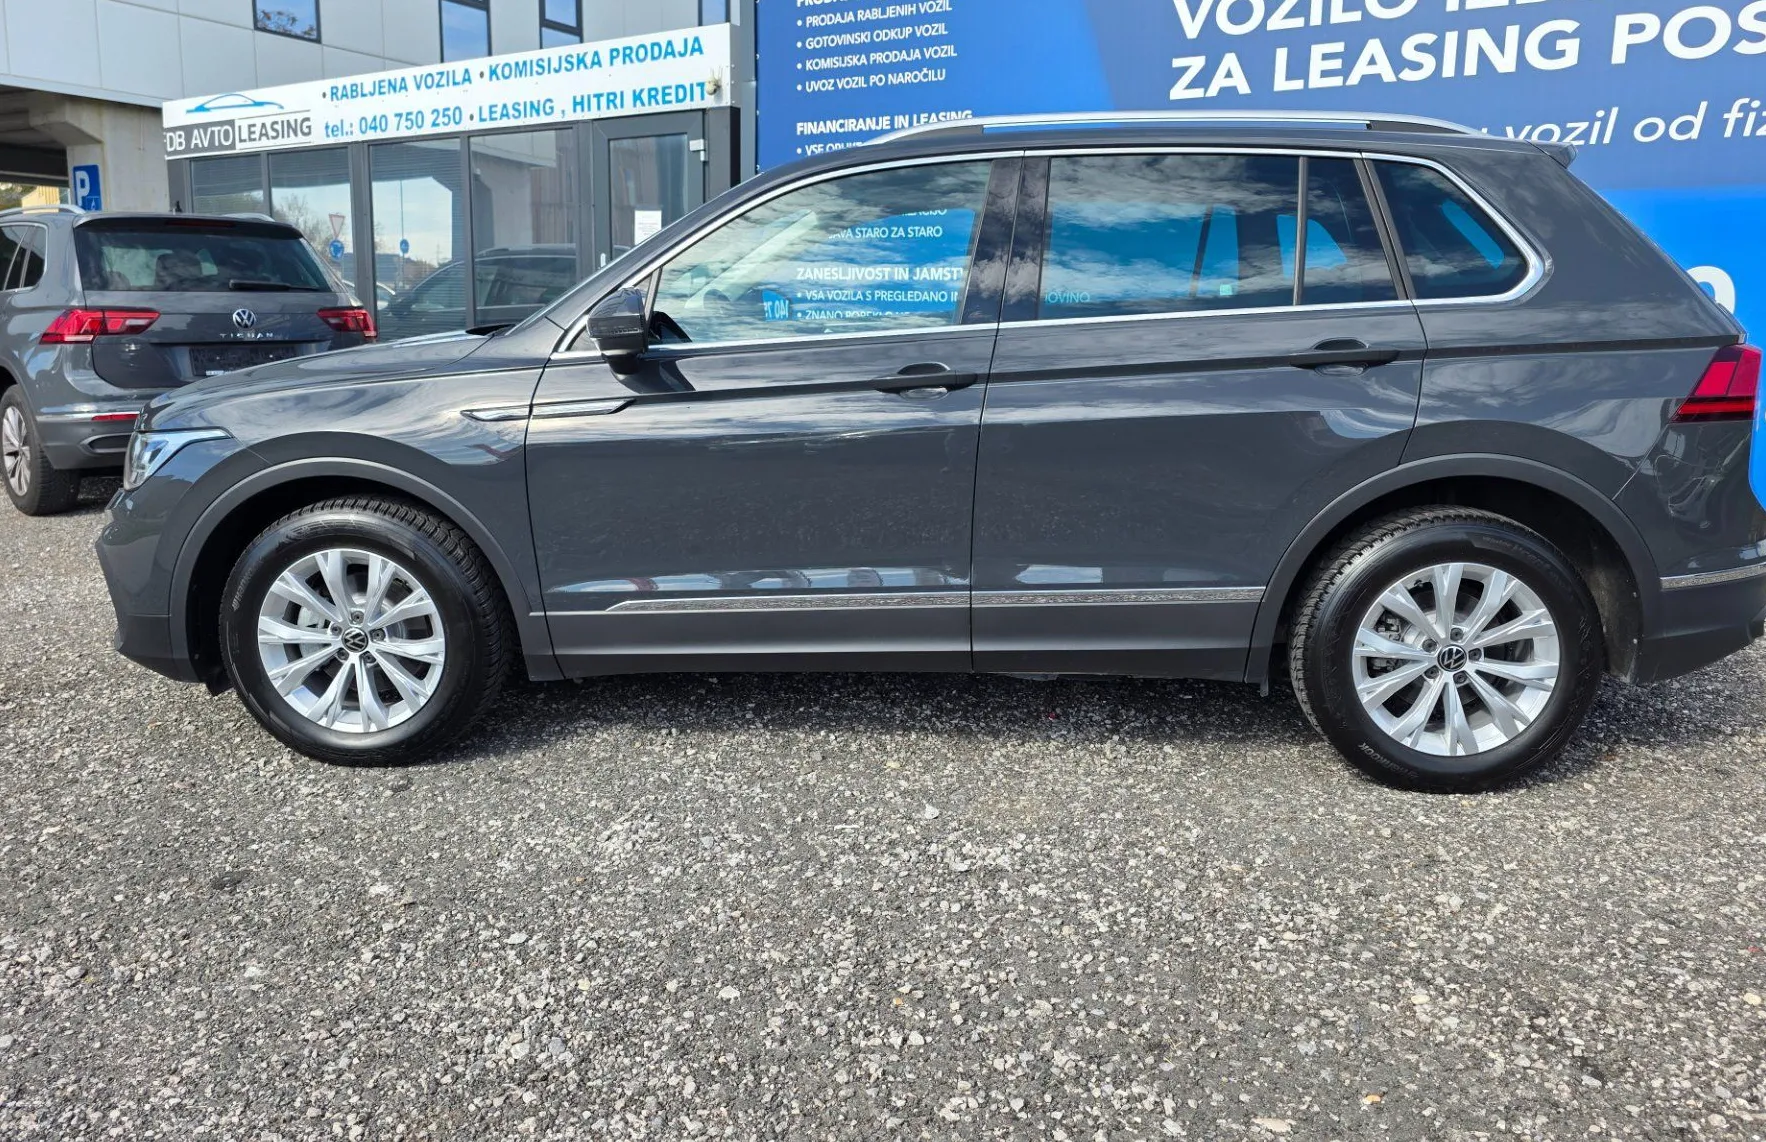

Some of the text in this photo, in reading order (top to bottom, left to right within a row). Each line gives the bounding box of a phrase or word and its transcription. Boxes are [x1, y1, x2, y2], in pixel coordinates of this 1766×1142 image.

[805, 12, 855, 28] PRODAJA
[857, 4, 916, 22] RABLJENIH
[918, 0, 953, 14] VOZIL
[805, 23, 948, 49] GOTOVINSKI ODKUP VOZIL
[330, 36, 704, 101] RABLJENA VOZILA KOMISIJSKA PRODAJA
[805, 45, 957, 71] KOMISIJSKA PRODAJA VOZIL
[1170, 52, 1251, 100] ZA
[1273, 19, 1581, 92] LEASING
[805, 68, 946, 92] UVOZ VOZIL PO NAROČILU
[324, 119, 354, 138] tel.:
[359, 114, 388, 134] 040
[394, 110, 425, 131] 750
[431, 106, 463, 128] 250
[478, 98, 555, 123] LEASING
[572, 90, 625, 113] HITRI
[632, 82, 707, 108] KREDIT
[1506, 107, 1619, 146] vozil
[1633, 101, 1709, 142] od
[191, 125, 233, 149] AVTO
[238, 117, 312, 143] LEASING
[796, 116, 891, 135] FINANCIRANJE
[894, 115, 909, 129] IN
[75, 170, 90, 207] P
[855, 227, 889, 239] STARO
[890, 227, 905, 238] ZA
[907, 226, 943, 238] STARO
[796, 268, 889, 281] ZANESLJIVOST
[894, 268, 909, 280] IN
[805, 291, 826, 301] VSA
[827, 290, 863, 301] VOZILA
[866, 290, 872, 300] S
[874, 291, 948, 302] PREGLEDANO
